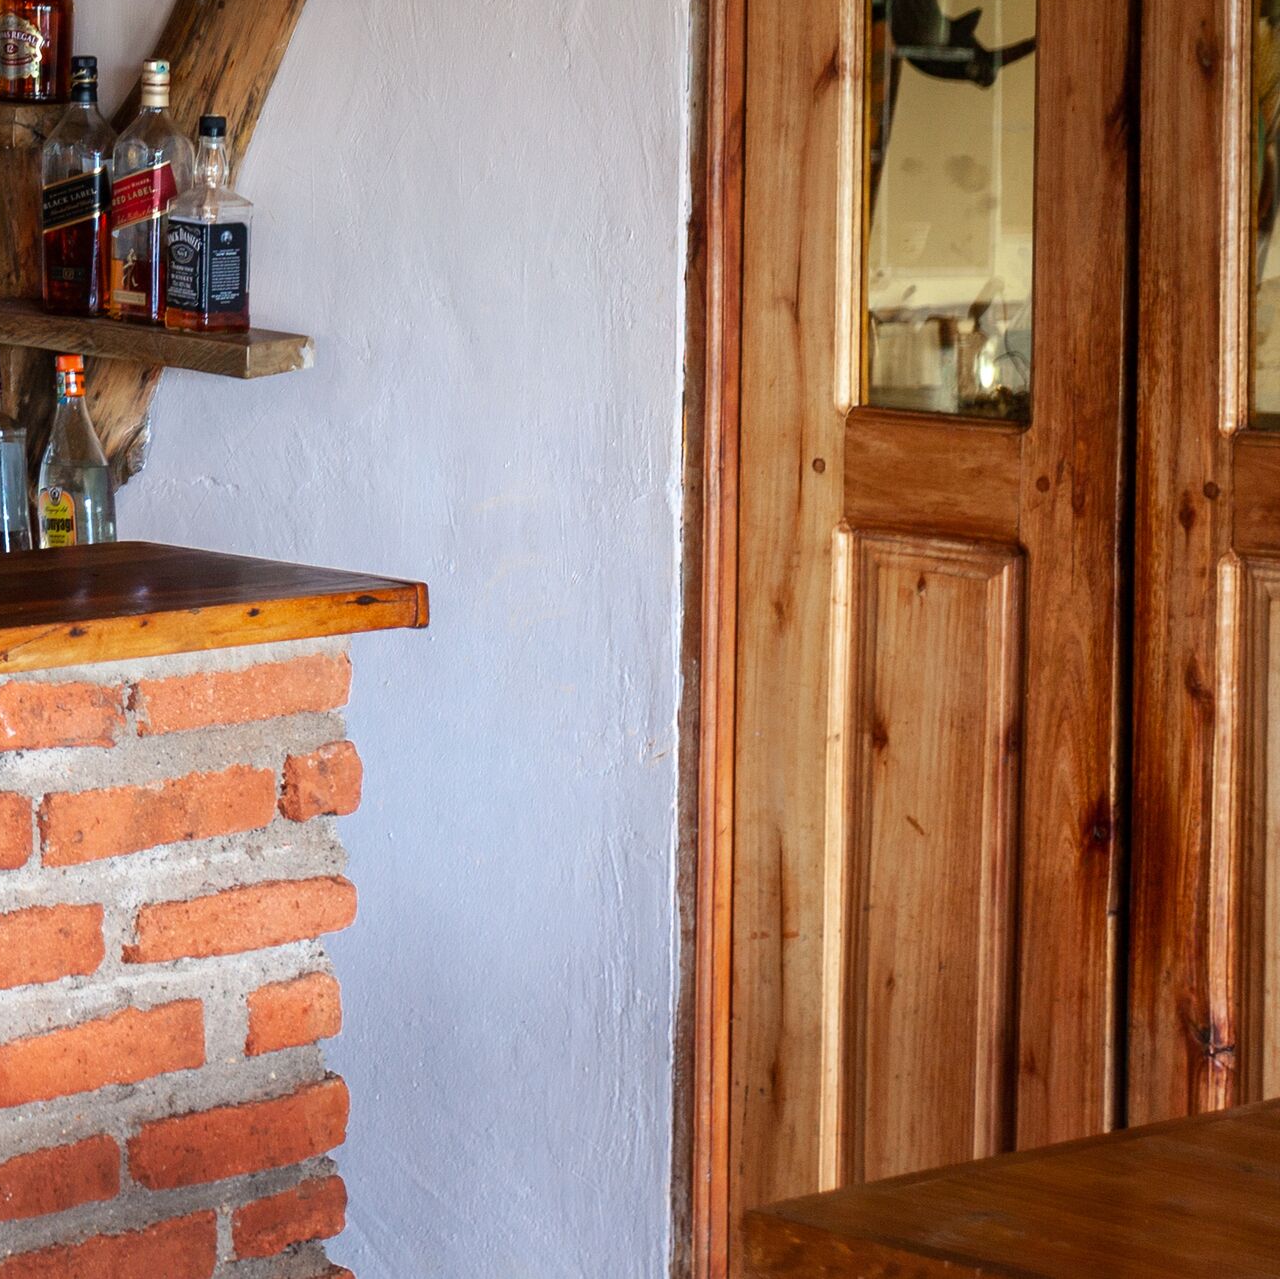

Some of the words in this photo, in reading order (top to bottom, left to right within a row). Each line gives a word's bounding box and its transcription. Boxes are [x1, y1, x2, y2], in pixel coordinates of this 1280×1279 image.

[11, 31, 38, 46] REGAL
[70, 188, 97, 201] LABEL
[111, 194, 126, 207] RED
[127, 185, 155, 201] LABEL
